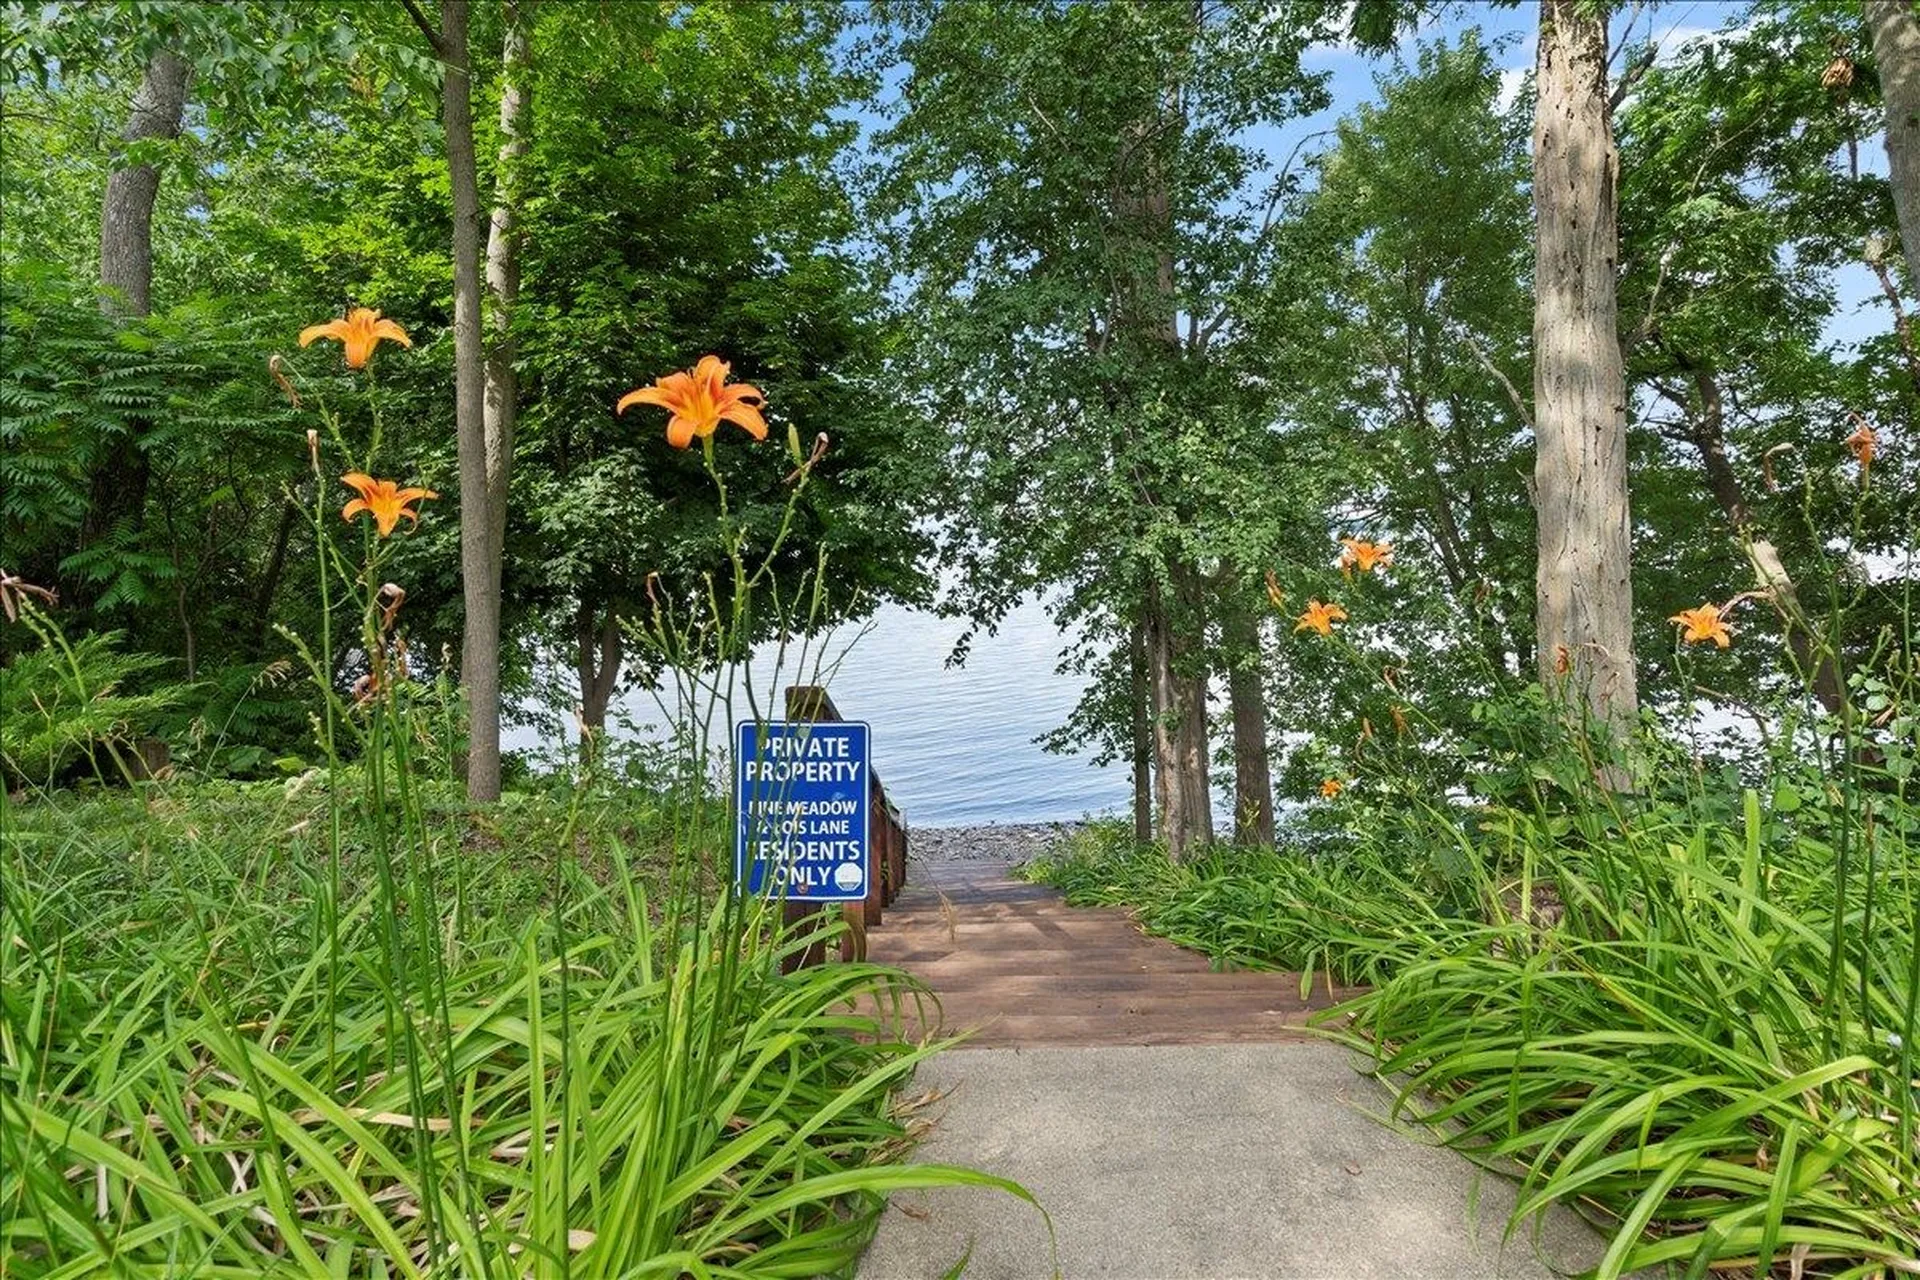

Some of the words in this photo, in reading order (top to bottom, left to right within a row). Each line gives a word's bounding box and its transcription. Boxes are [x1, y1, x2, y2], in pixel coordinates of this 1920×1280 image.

[746, 761, 860, 782] PROPERTY
[786, 800, 858, 815] MEADOW
[810, 820, 850, 835] LANE
[774, 866, 832, 886] ONLY
